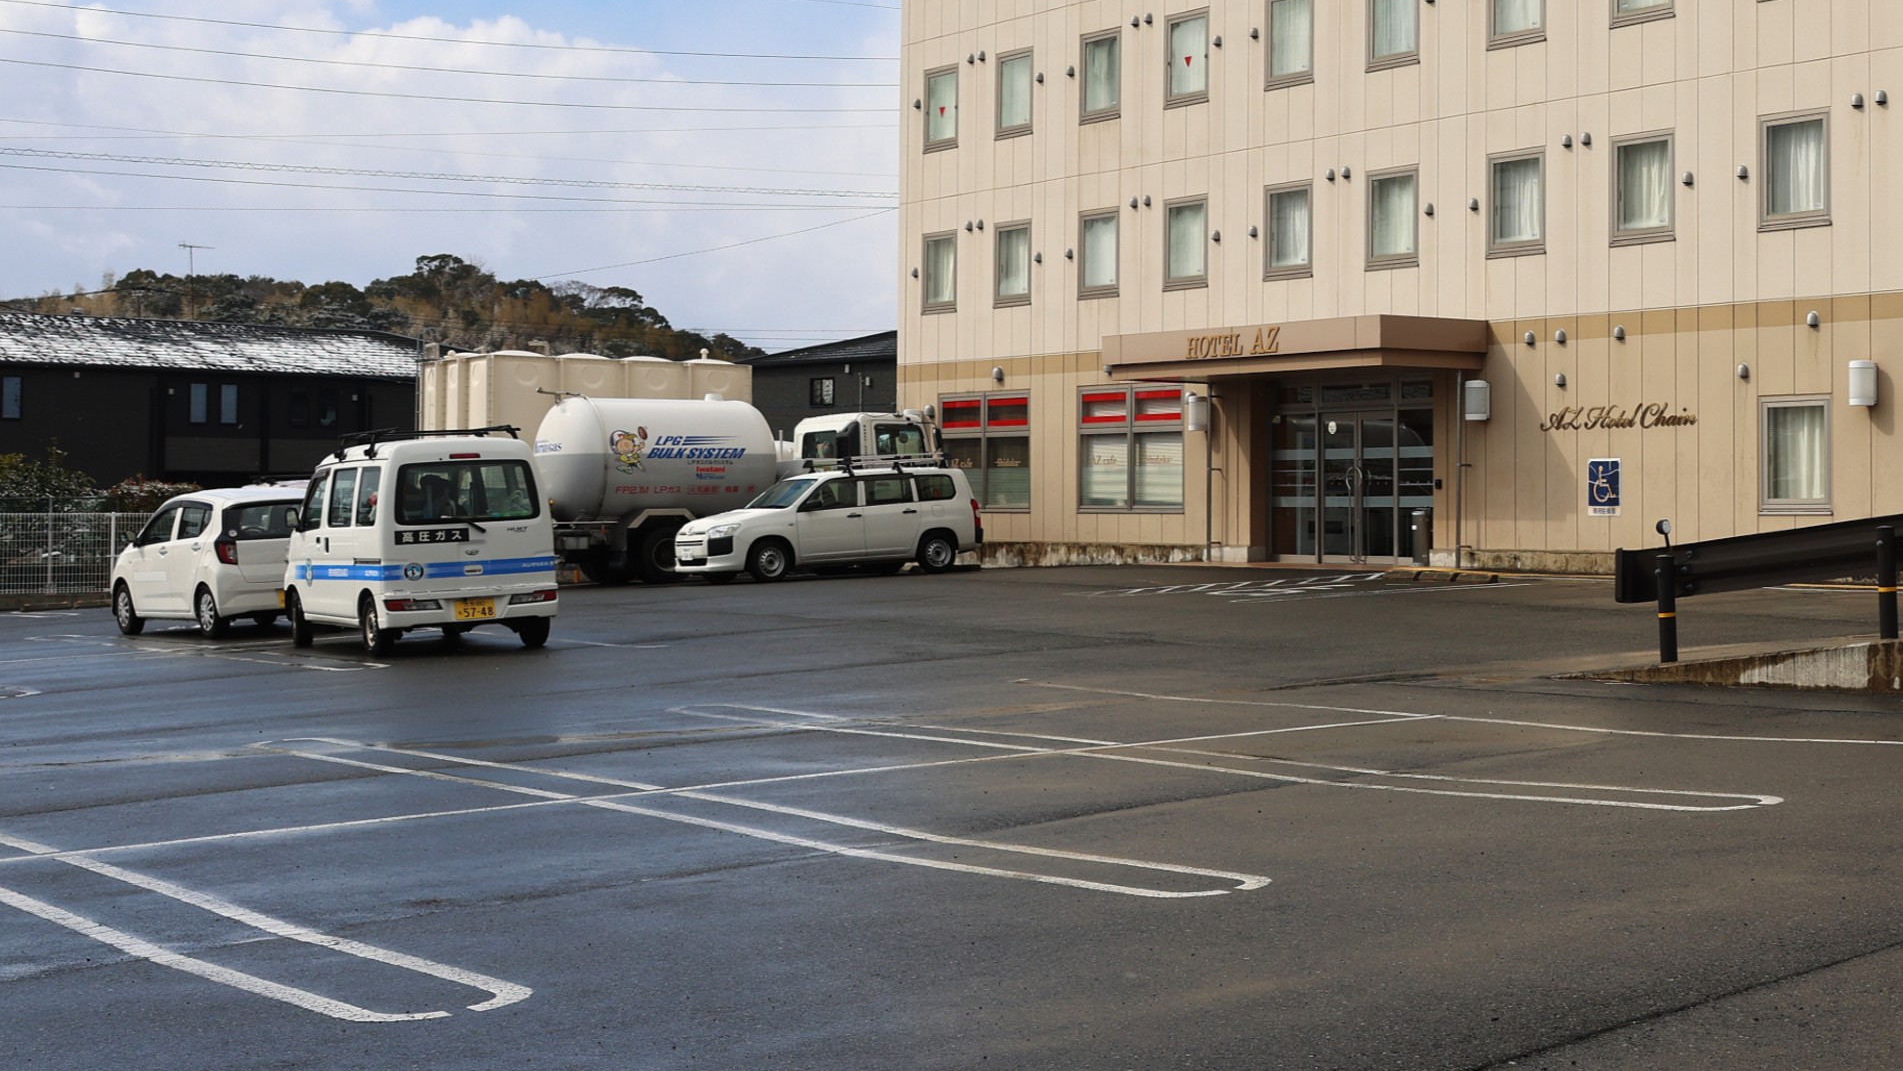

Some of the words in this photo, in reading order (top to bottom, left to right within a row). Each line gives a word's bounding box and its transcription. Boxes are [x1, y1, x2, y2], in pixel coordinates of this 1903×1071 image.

[1186, 333, 1244, 359] HOTEL
[1250, 326, 1280, 355] AZ
[1540, 405, 1584, 432] AZ
[1583, 403, 1643, 430] Hotel
[1639, 401, 1698, 430] Chain
[655, 436, 683, 446] LPG
[647, 448, 687, 459] BULK
[686, 447, 746, 459] SYSTEM
[402, 530, 462, 542] 高圧ガス
[463, 607, 494, 618] 57-48
